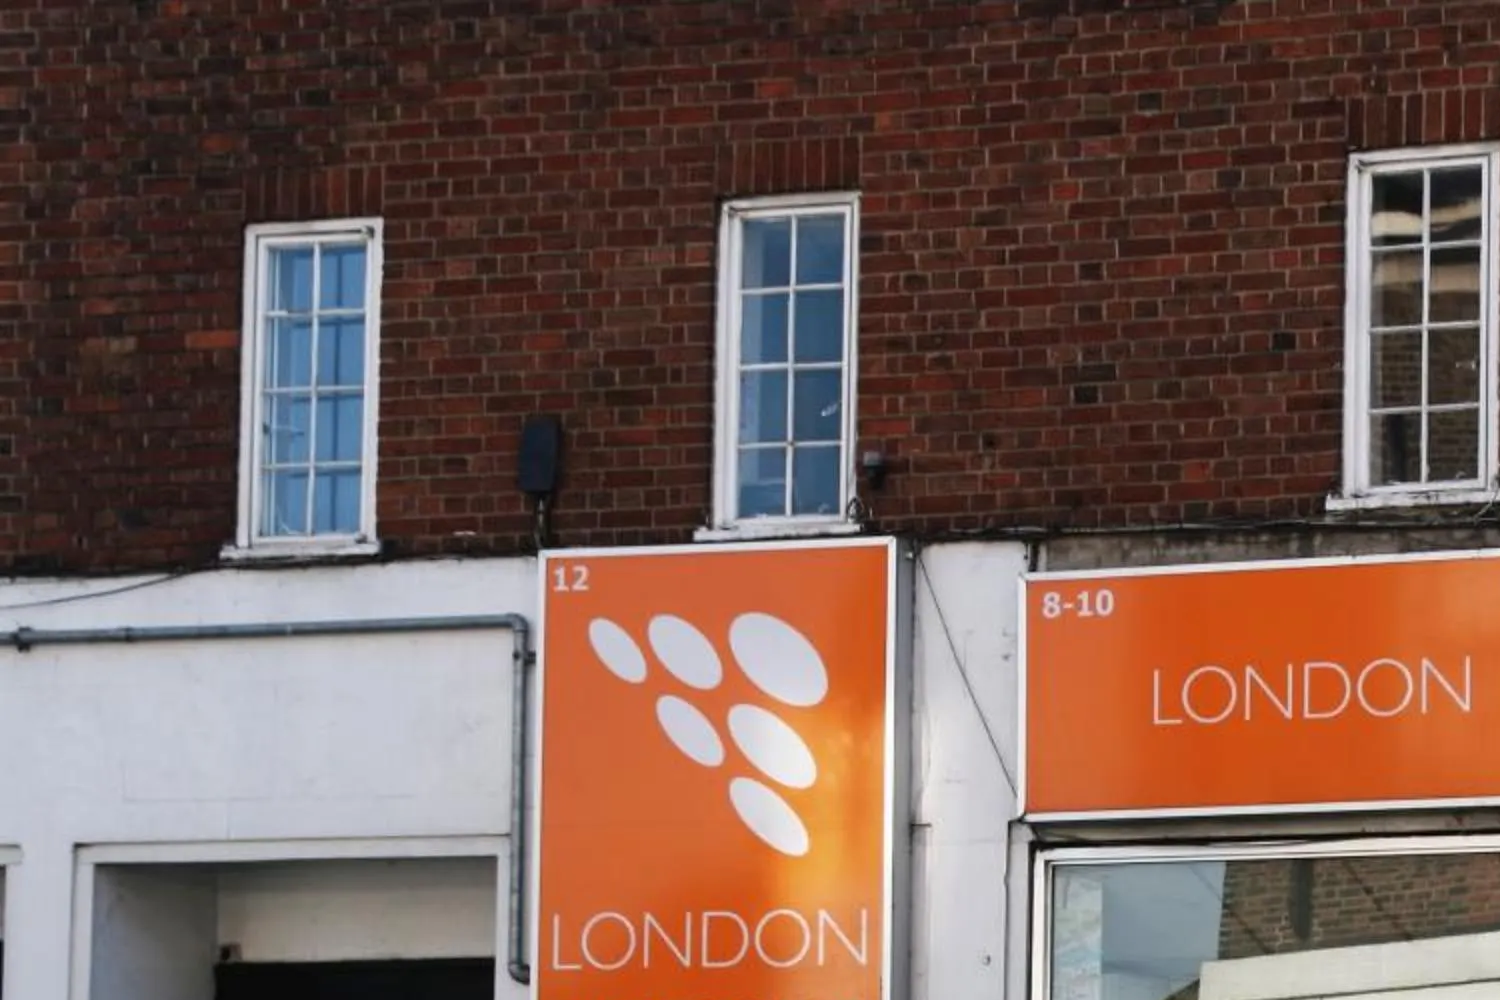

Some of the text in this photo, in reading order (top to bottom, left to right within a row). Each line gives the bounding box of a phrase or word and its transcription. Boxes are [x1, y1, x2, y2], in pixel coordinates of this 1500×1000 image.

[553, 565, 590, 592] 12
[1041, 588, 1115, 620] 8-10
[1153, 656, 1472, 725] LONDON
[552, 908, 868, 971] LONDON
